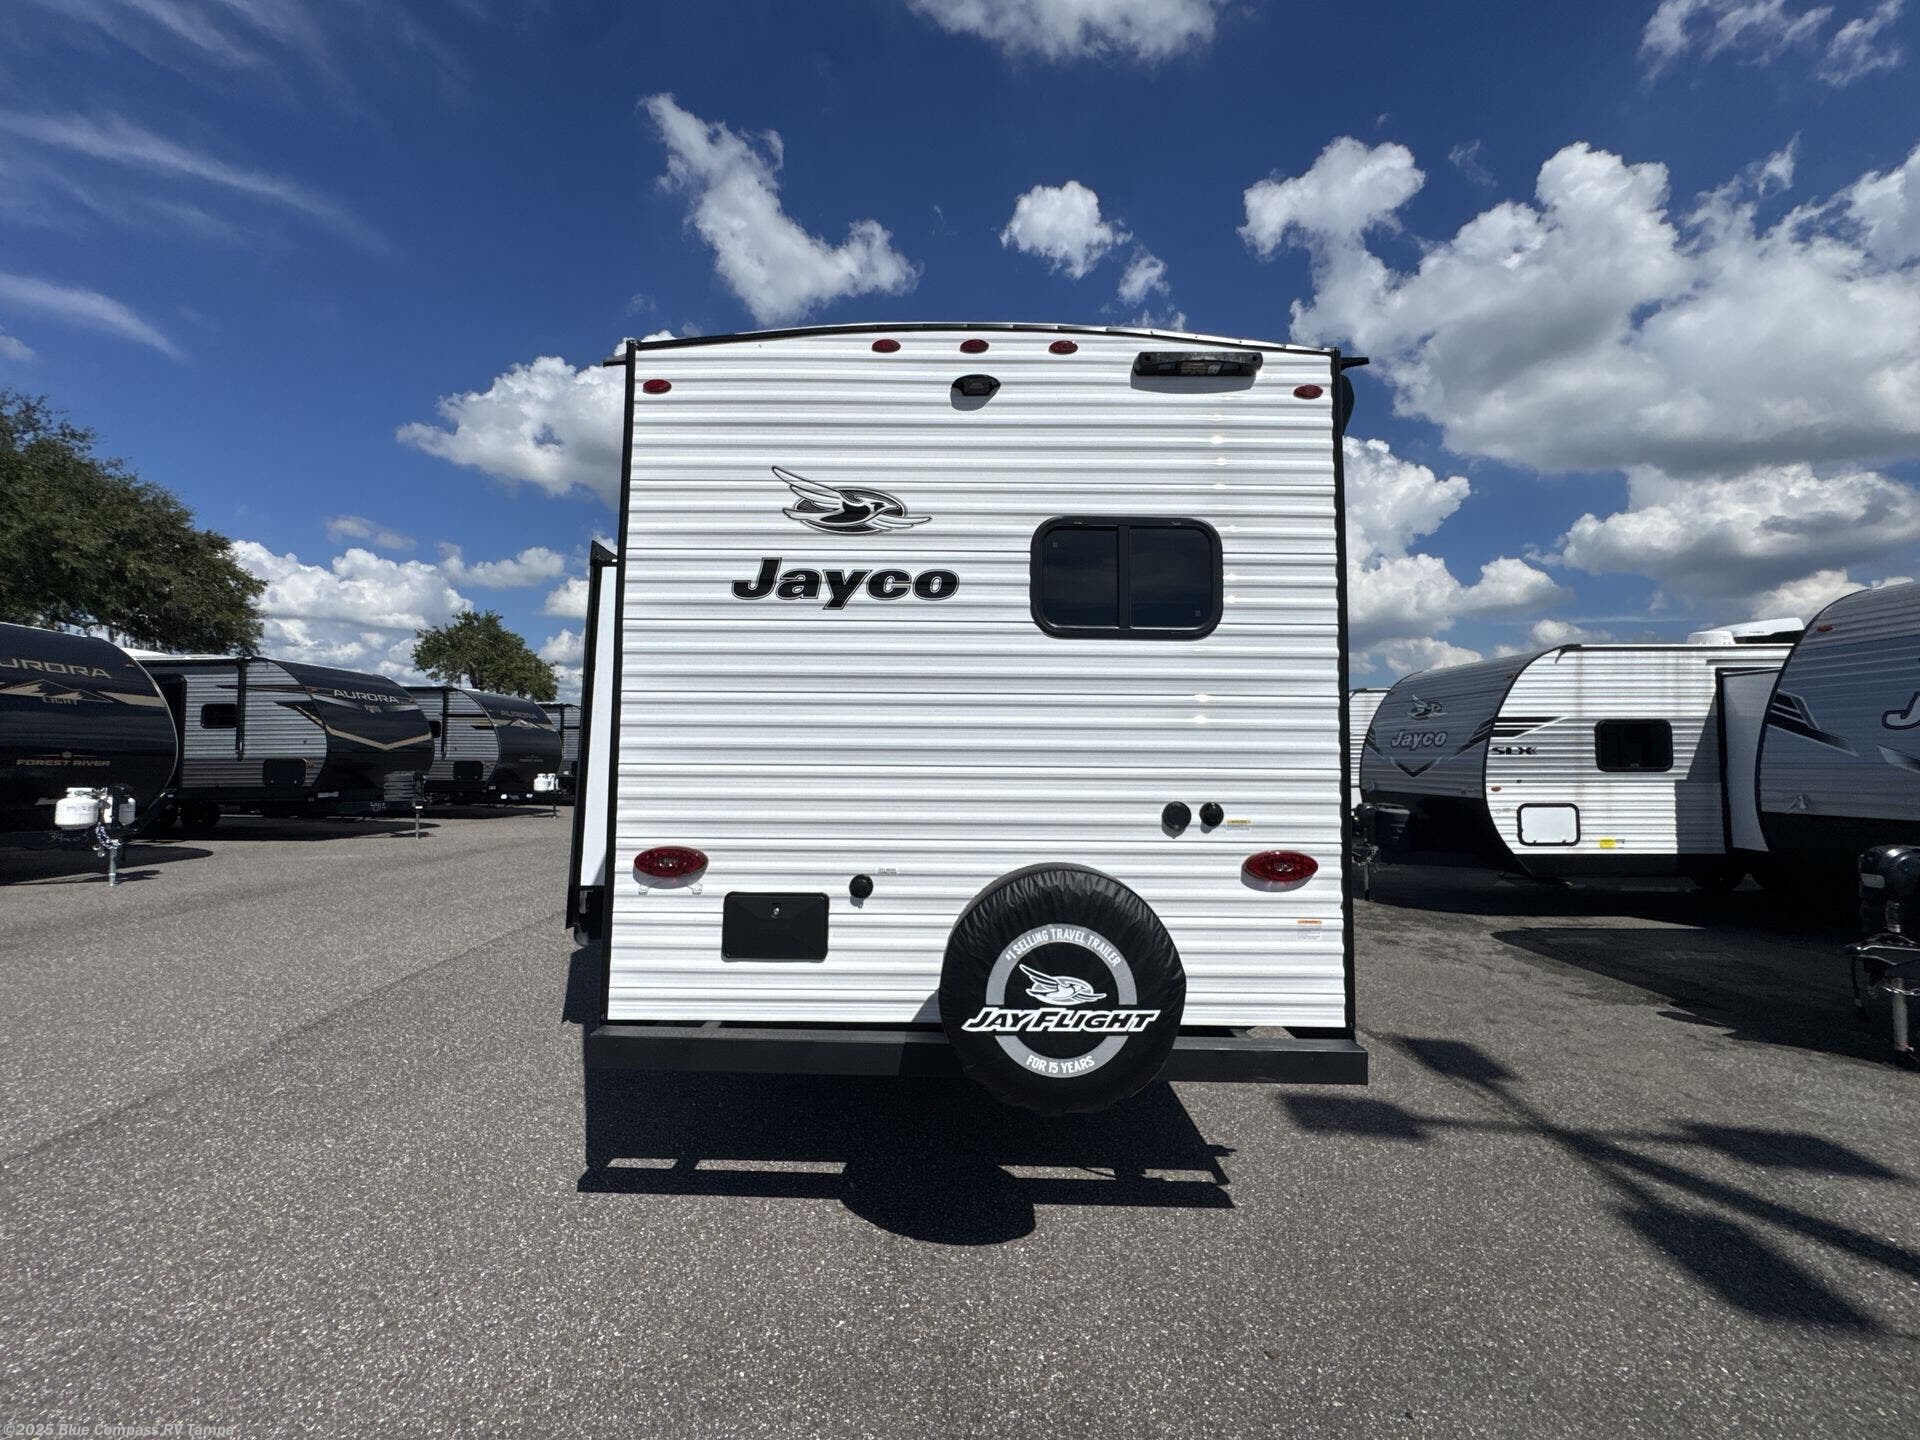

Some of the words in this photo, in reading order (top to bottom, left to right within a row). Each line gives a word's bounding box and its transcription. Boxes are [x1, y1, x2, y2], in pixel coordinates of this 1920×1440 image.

[731, 557, 960, 610] Jayco
[333, 689, 400, 704] AURORA
[1391, 729, 1448, 751] Jayco
[1012, 930, 1049, 955] SELLING
[1050, 928, 1085, 944] TRAVEL
[1085, 935, 1122, 967] TRAILER
[1026, 1055, 1046, 1072] FOR
[1048, 1061, 1058, 1074] 15
[1060, 1055, 1095, 1074] YEARS
